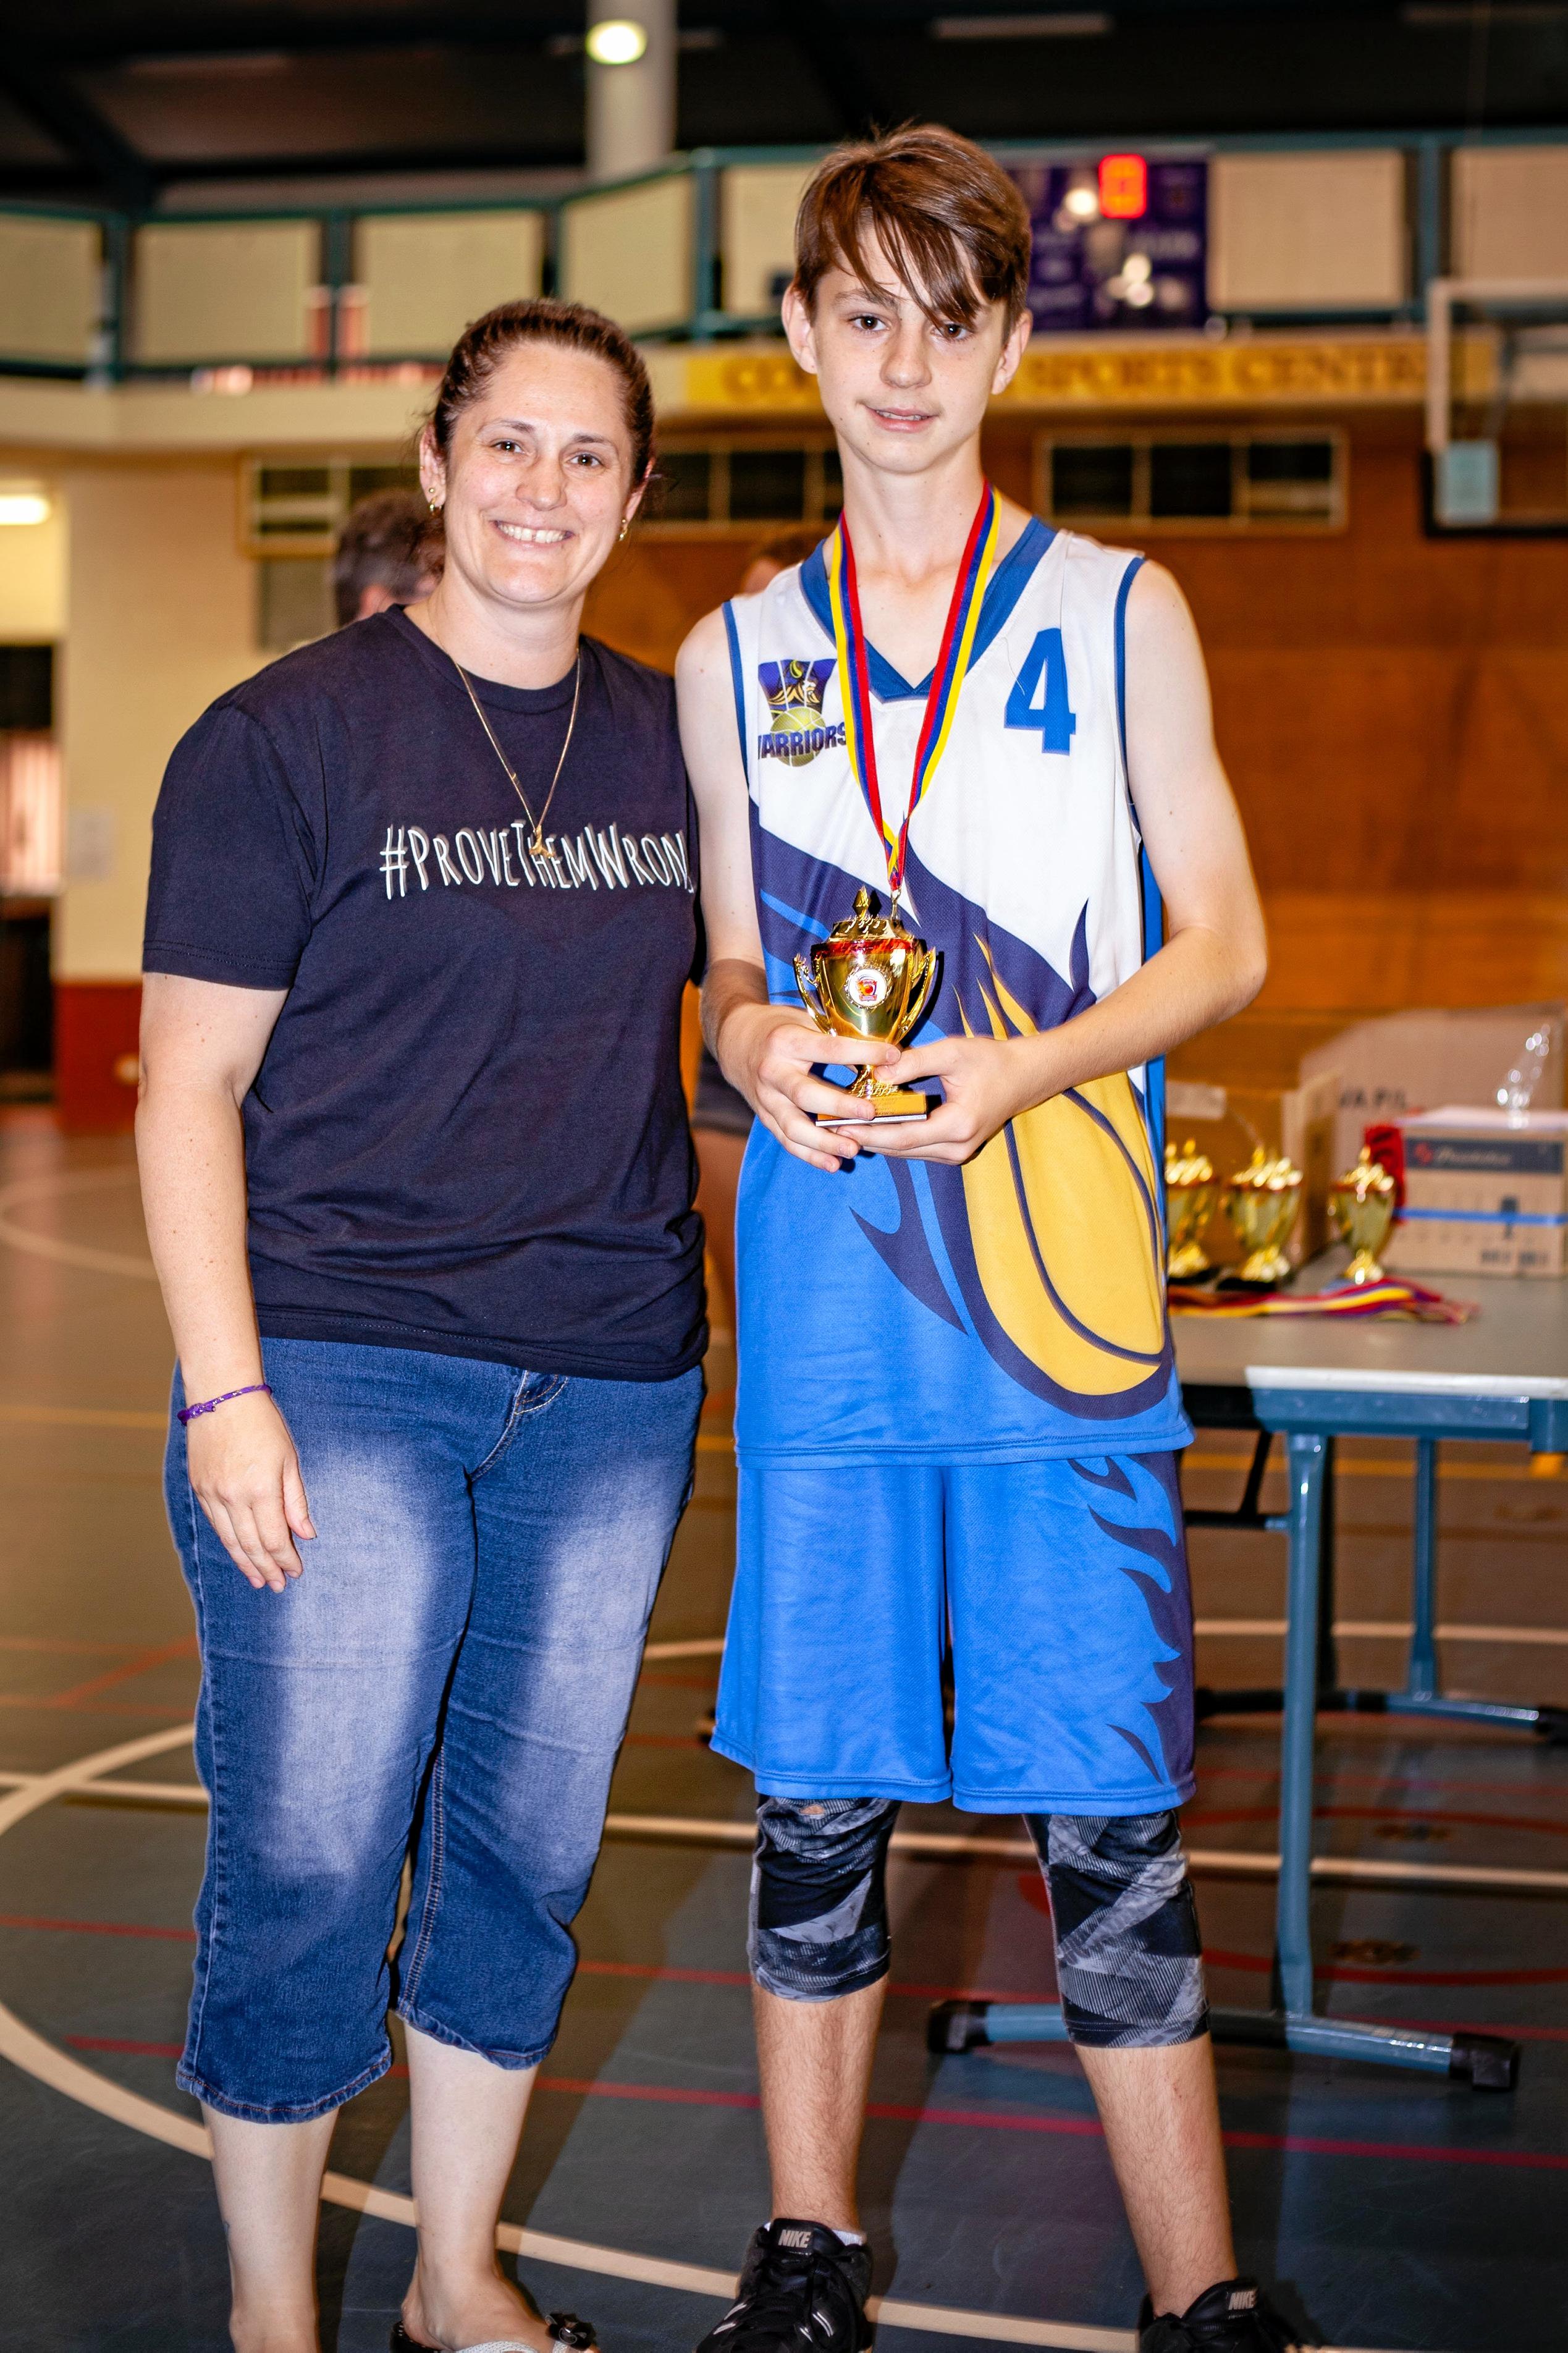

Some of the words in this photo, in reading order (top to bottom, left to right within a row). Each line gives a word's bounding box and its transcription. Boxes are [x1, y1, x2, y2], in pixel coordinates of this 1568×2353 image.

[1004, 628, 1076, 756] 4
[758, 722, 846, 759] ARRIORS
[778, 2229, 811, 2248] NIKE
[1228, 2290, 1256, 2310] NIKE
